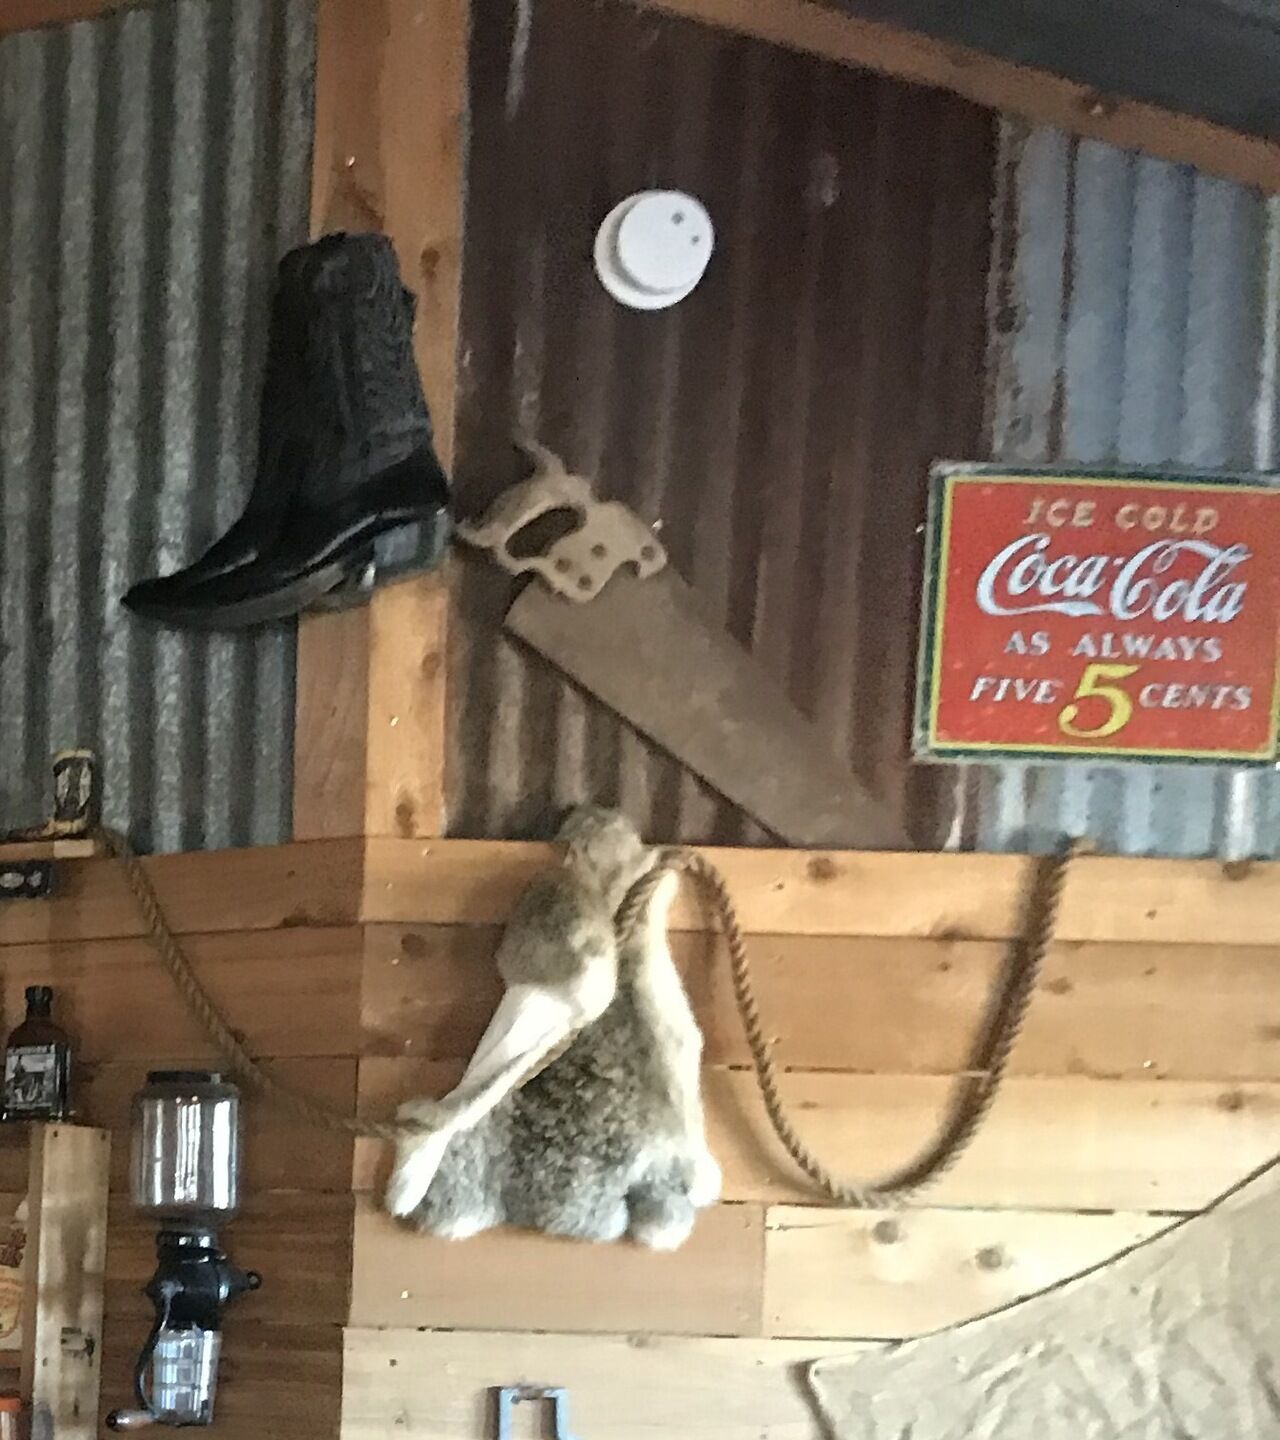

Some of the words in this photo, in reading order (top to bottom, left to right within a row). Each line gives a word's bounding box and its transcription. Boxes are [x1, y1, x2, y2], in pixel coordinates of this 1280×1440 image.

[1022, 498, 1097, 528] ICE
[1114, 503, 1220, 535] COLD
[1004, 630, 1051, 656] AS
[1071, 631, 1224, 662] ALWAYS
[969, 676, 1064, 704] FIVE
[1056, 662, 1141, 738] 5
[1139, 682, 1253, 711] CENTS
